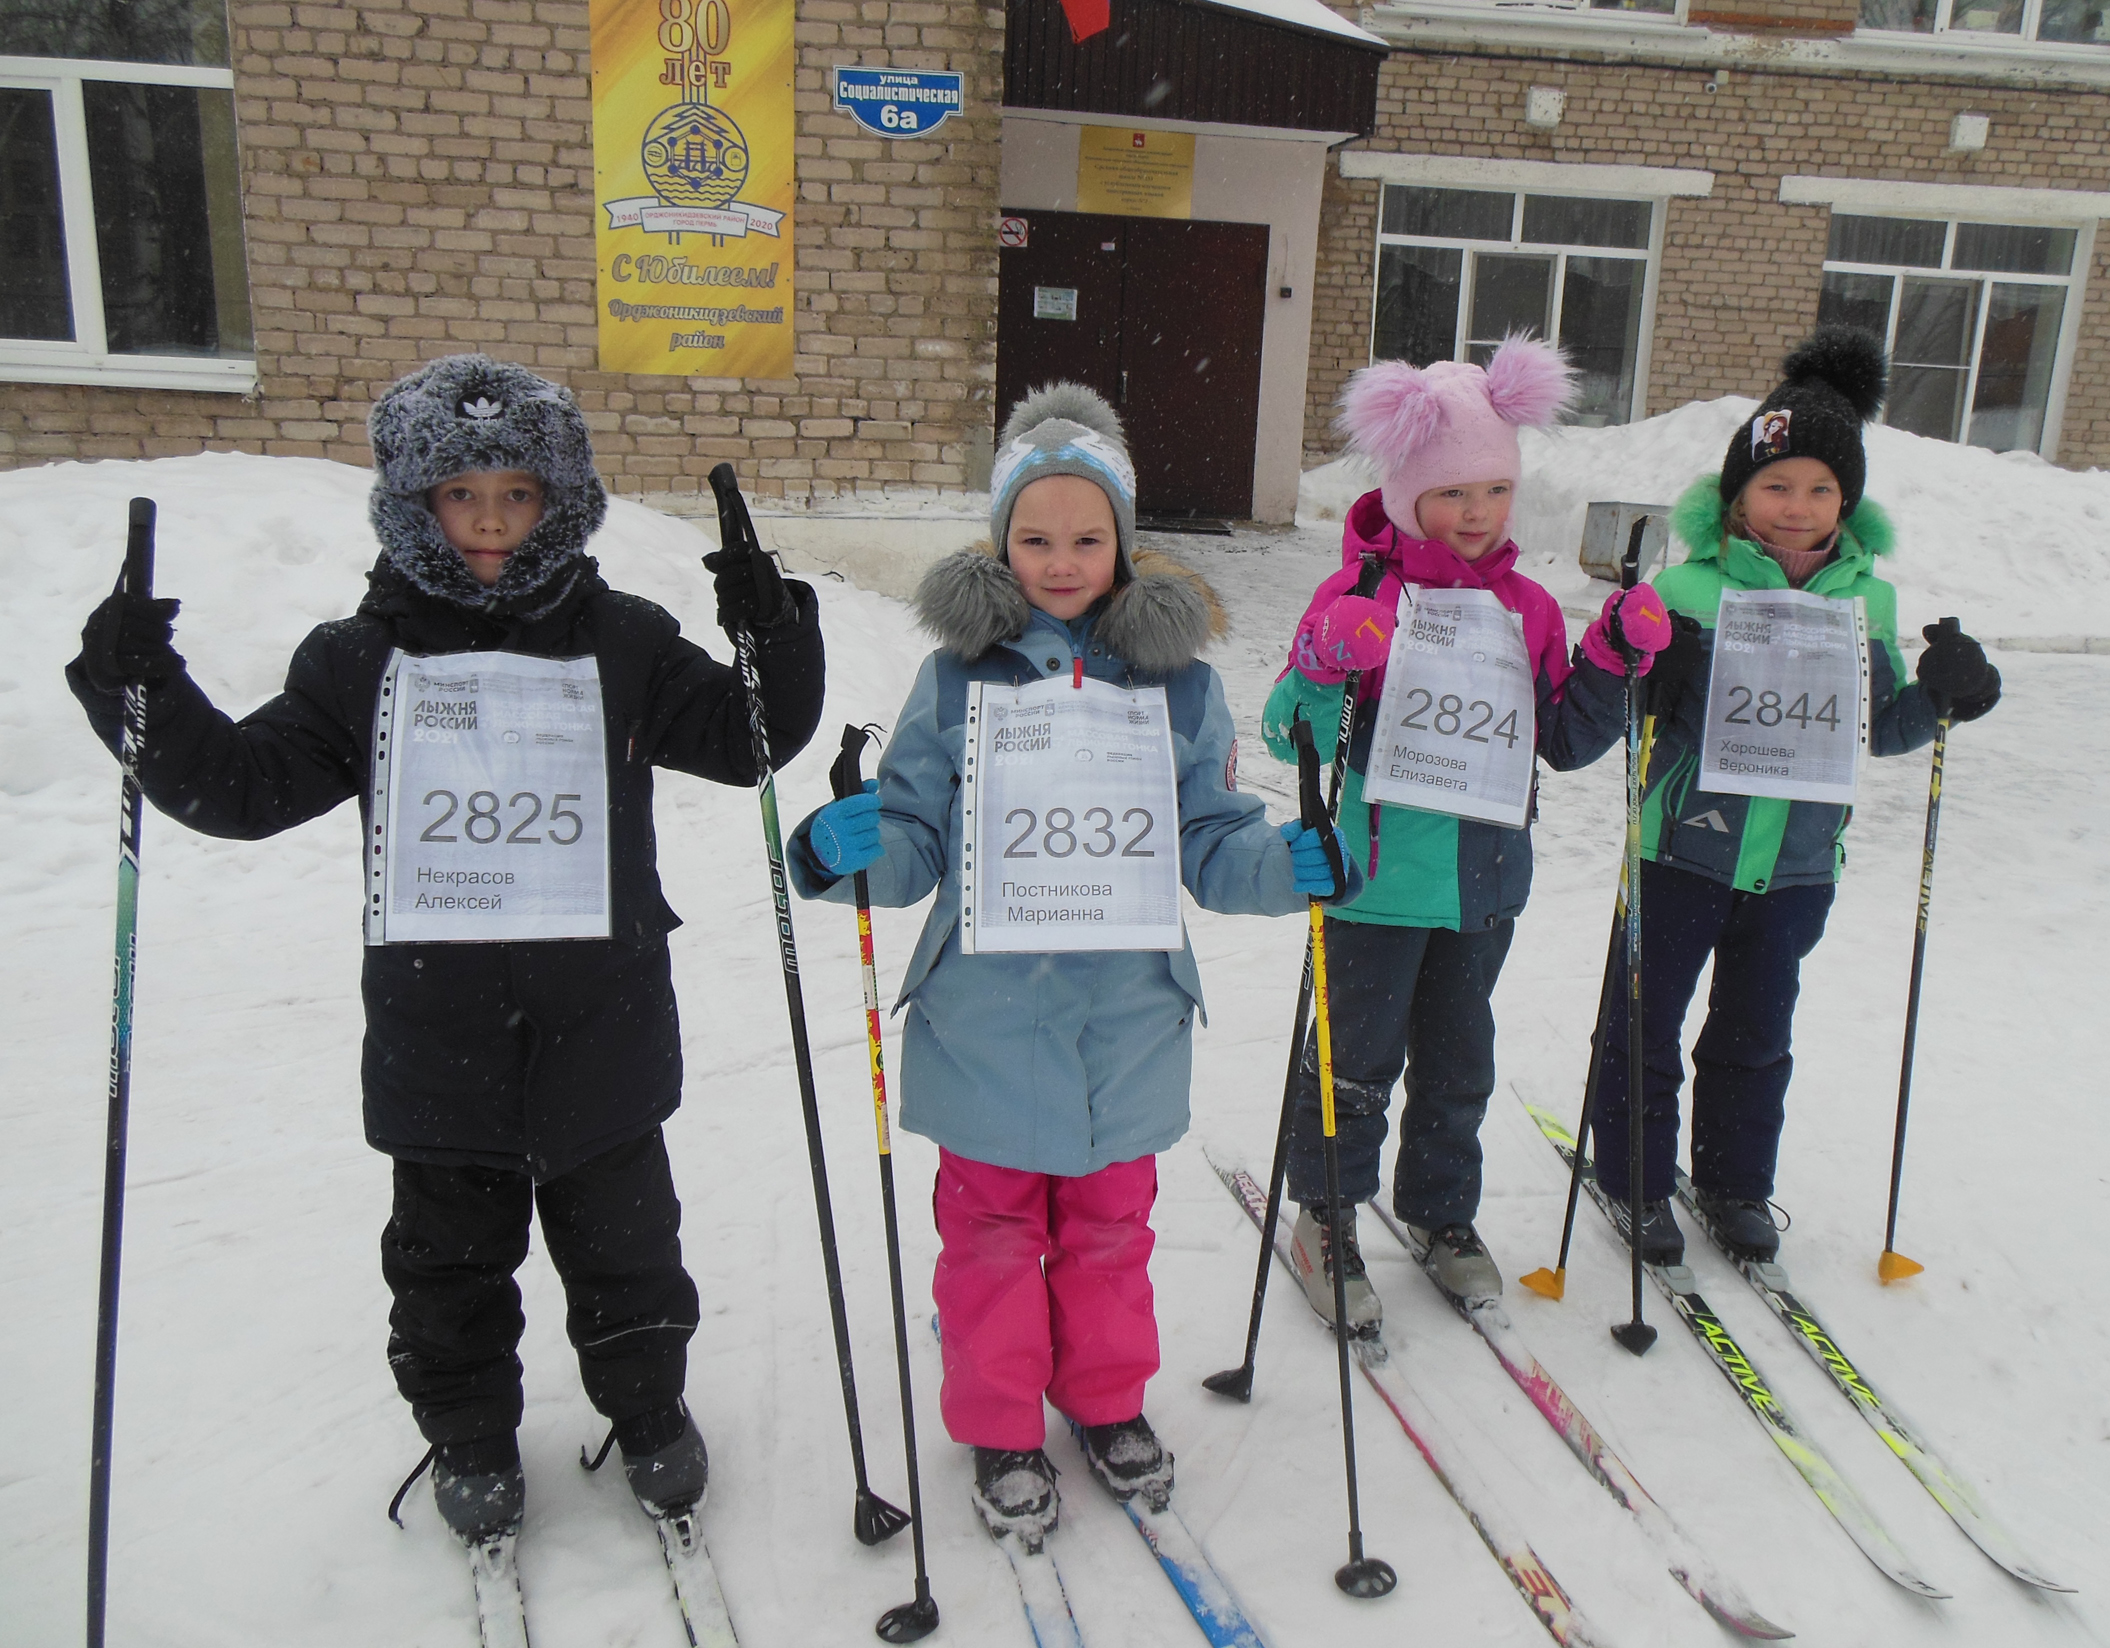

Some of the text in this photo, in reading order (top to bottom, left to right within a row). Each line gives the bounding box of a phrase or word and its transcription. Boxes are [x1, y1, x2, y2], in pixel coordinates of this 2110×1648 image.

[658, 0, 731, 55] 80
[659, 57, 731, 88] лет
[880, 75, 918, 85] улица
[839, 81, 959, 104] Социалистическая
[616, 212, 639, 223] 1940
[723, 214, 745, 223] РАЙОН
[750, 219, 773, 231] 2020
[611, 253, 779, 289] С Юбилеем!
[608, 299, 783, 326] Орджоникидзевский
[669, 330, 725, 352] район
[1725, 620, 1772, 634] ЛЫЖНЯ
[1408, 630, 1455, 648] РОССИИ
[1724, 630, 1770, 645] РОССИИ
[1724, 641, 1754, 654] 2021
[413, 699, 477, 716] ЛЫЖНЯ
[1724, 685, 1841, 732] 2844
[414, 714, 478, 730] РОССИИ
[1400, 688, 1519, 749] 2824
[413, 729, 459, 744] 2021
[993, 722, 1051, 739] ЛЫЖНЯ
[994, 737, 1051, 753] РОССИИ
[1720, 740, 1796, 758] Хорошева
[1393, 744, 1468, 771] Морозова
[1932, 723, 1947, 787] STC
[1719, 758, 1790, 776] Вероника
[1390, 764, 1468, 791] Елизавета
[419, 789, 583, 845] 2825
[1003, 807, 1155, 858] 2832
[417, 866, 515, 886] Некрасов
[1002, 881, 1113, 898] Постникова
[415, 892, 502, 910] Алексей
[1008, 906, 1104, 925] Марианна
